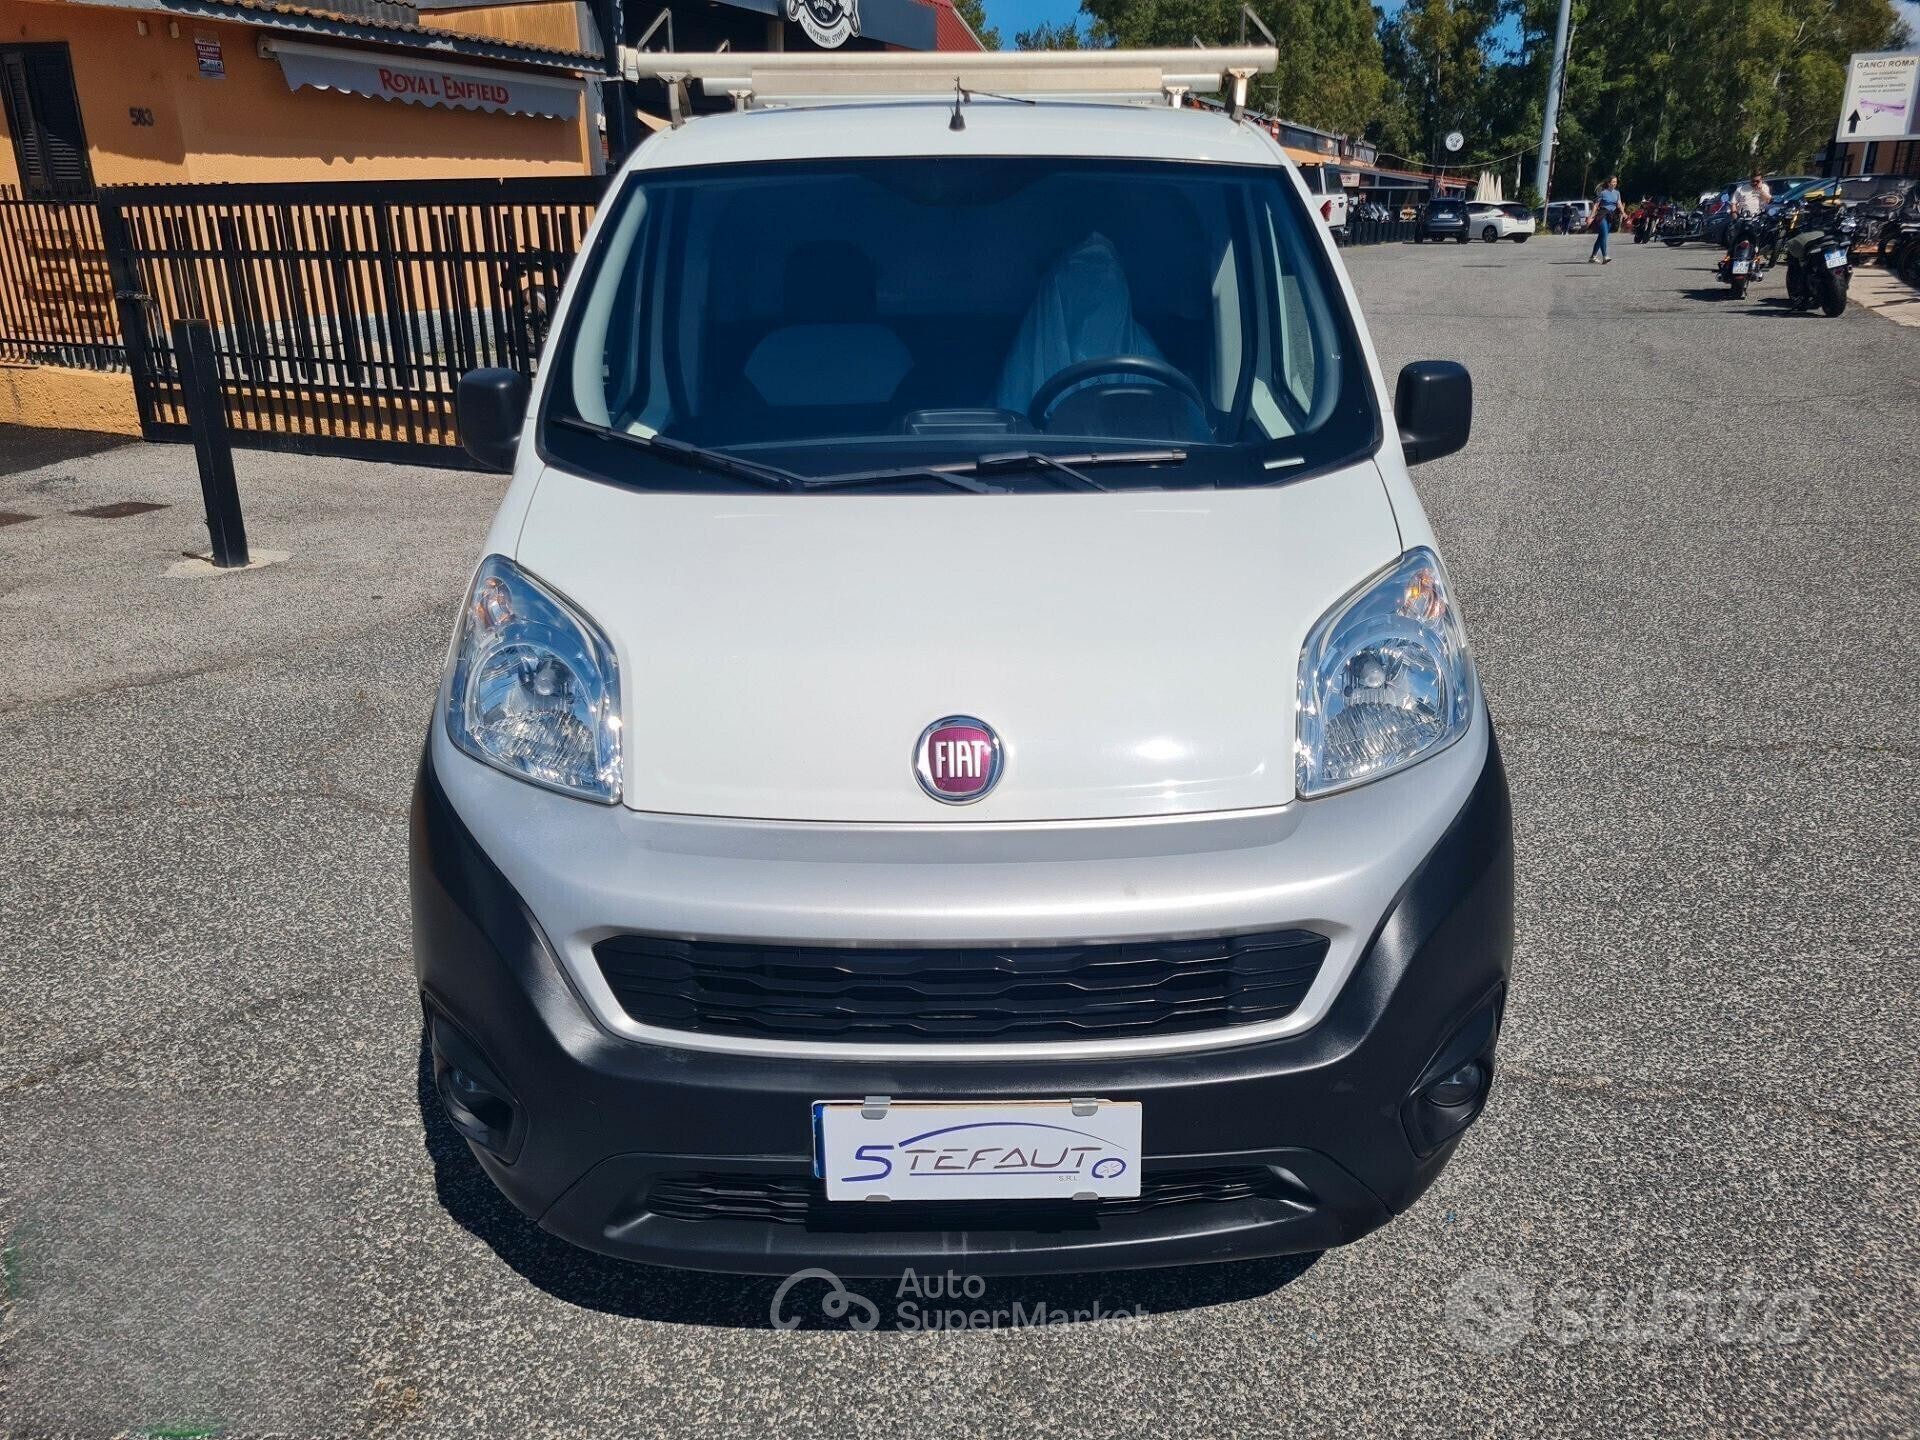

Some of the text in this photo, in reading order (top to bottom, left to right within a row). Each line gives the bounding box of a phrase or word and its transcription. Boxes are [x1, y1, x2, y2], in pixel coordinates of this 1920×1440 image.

[832, 26, 847, 43] STORE
[1857, 61, 1886, 69] GANCI
[379, 68, 510, 104] ROYAL ENFIELD
[129, 107, 154, 127] 583
[935, 740, 985, 778] FIAT
[841, 1145, 1127, 1183] STEFAUTO
